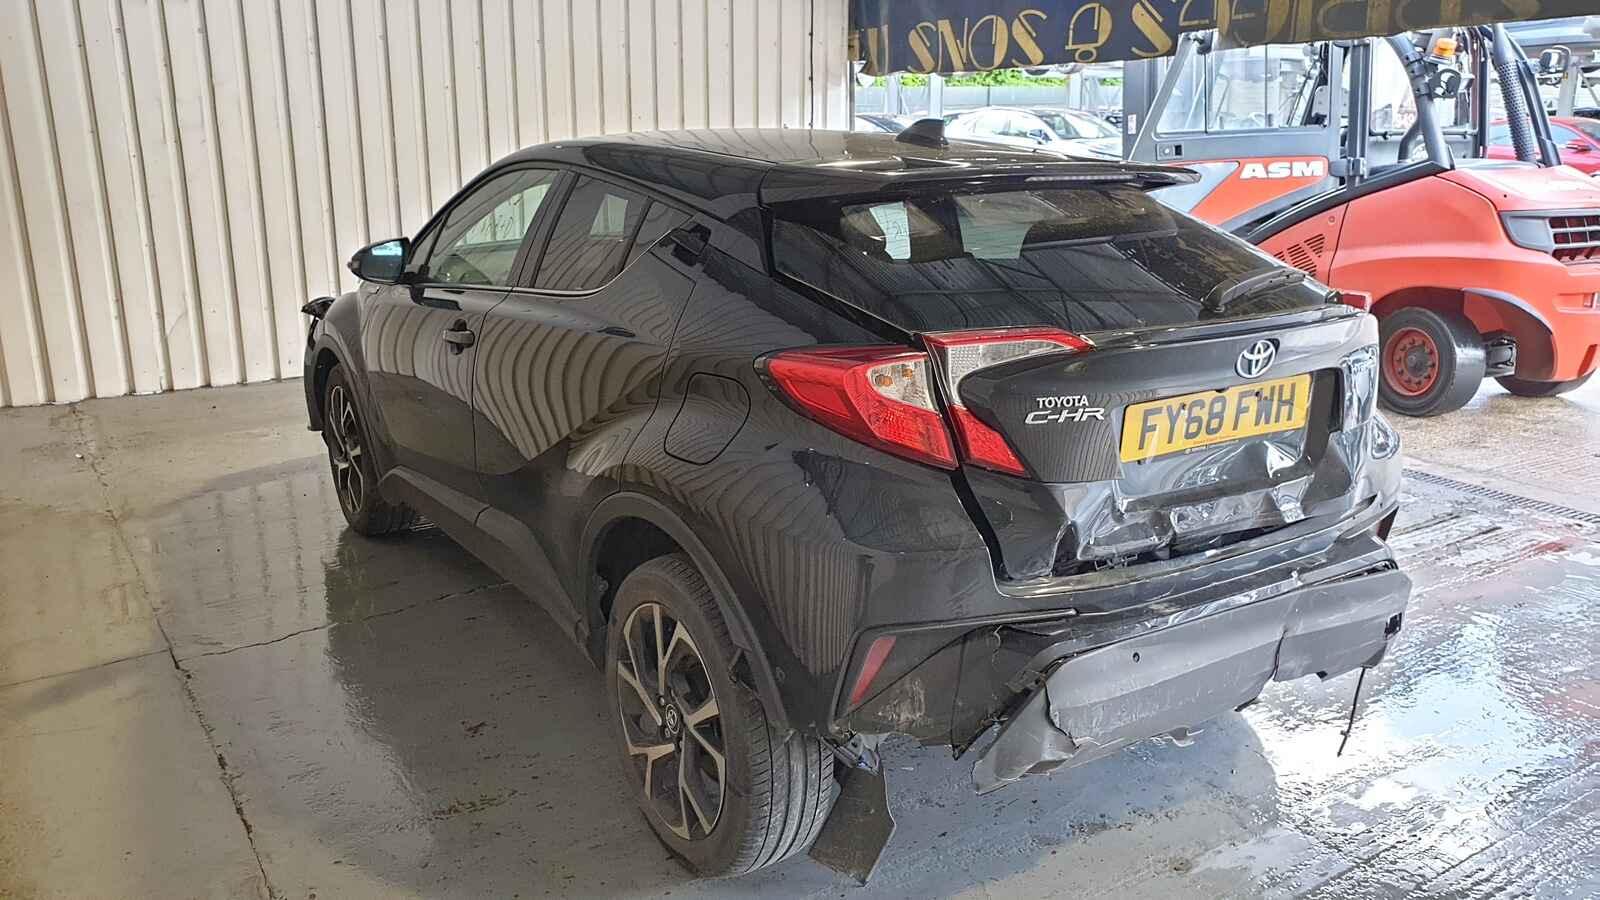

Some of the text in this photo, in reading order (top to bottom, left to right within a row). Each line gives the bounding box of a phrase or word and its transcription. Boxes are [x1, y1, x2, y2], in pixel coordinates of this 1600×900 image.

[907, 9, 1048, 74] SONS
[1065, 2, 1113, 63] &
[1240, 160, 1324, 179] ASM
[1024, 407, 1105, 425] C-HR
[1037, 395, 1089, 410] TOYOTA
[1138, 382, 1297, 450] FY68 FWH
